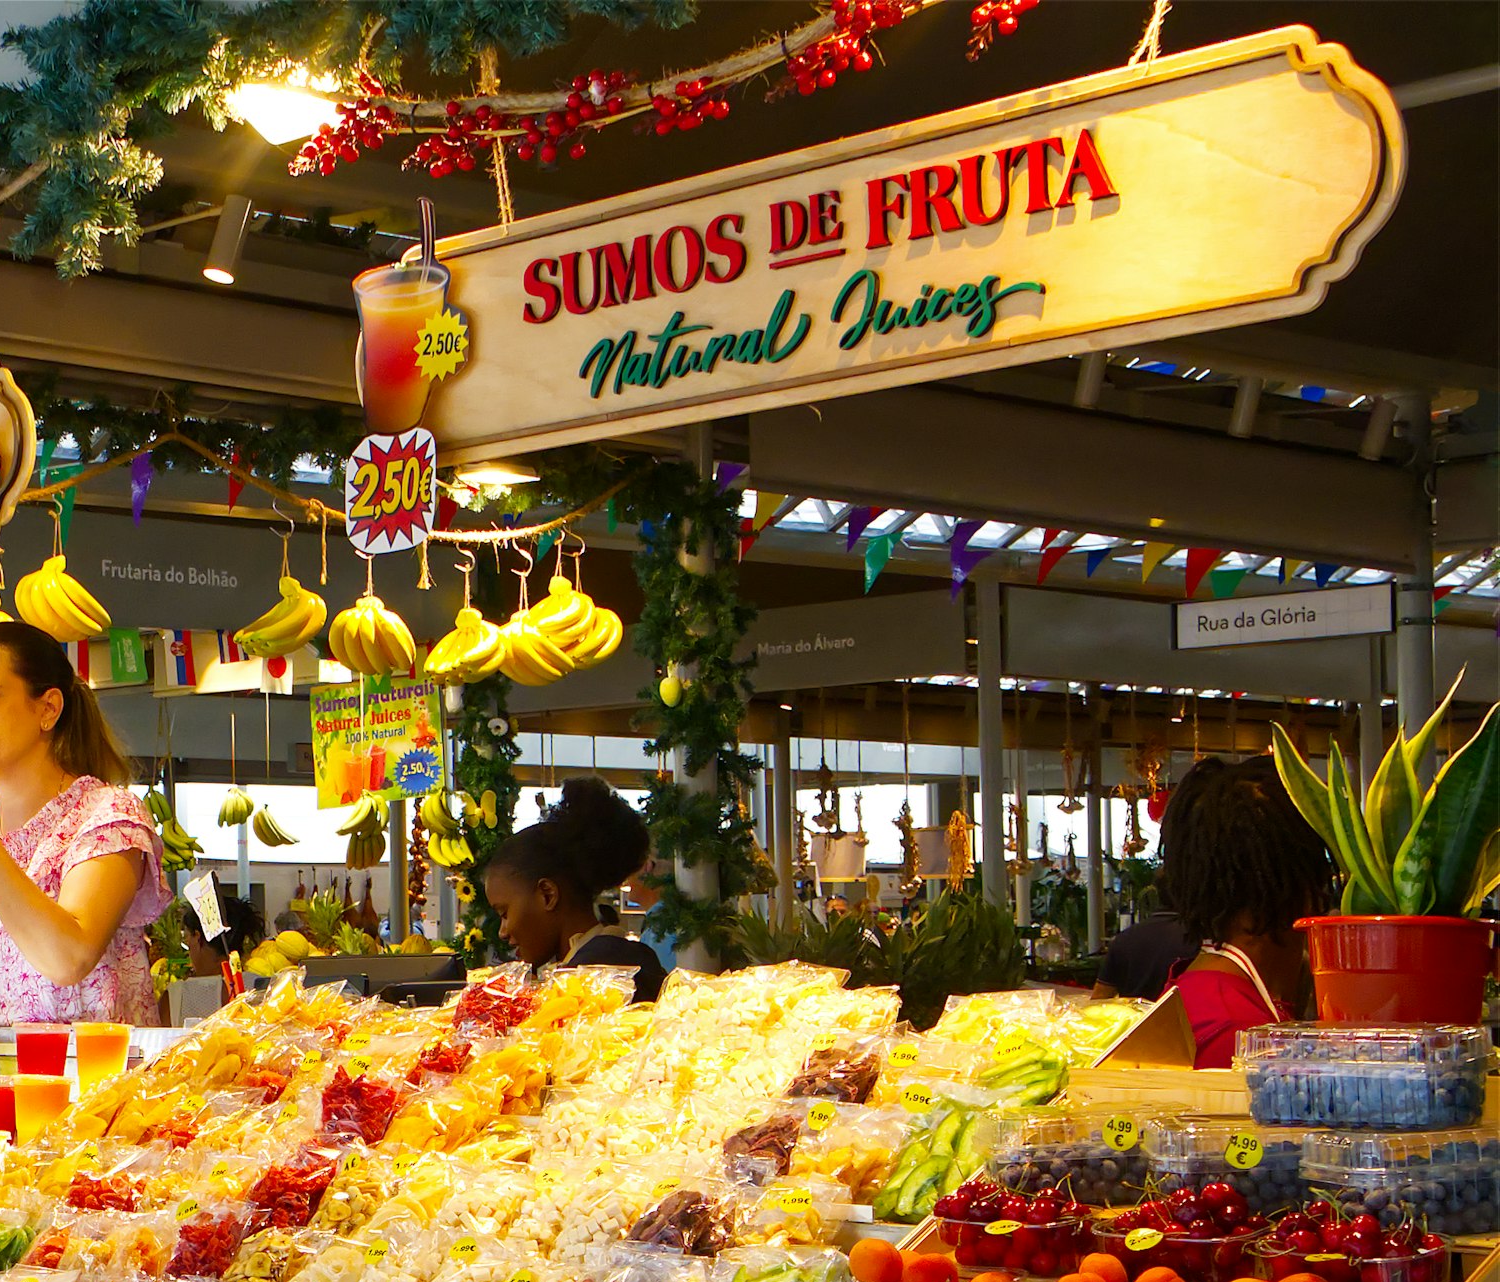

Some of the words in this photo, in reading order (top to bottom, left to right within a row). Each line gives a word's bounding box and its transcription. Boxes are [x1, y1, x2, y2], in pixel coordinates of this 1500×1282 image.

[523, 214, 747, 325] SUMOS
[769, 190, 844, 256] DE
[866, 129, 1119, 249] FRUTA
[580, 288, 812, 399] Natural
[832, 269, 1046, 351] Juices
[423, 332, 462, 358] 2,50€
[350, 457, 433, 521] 2,50€
[101, 559, 161, 582] Frutaria
[164, 566, 185, 584] do
[188, 567, 238, 588] Bolhão
[1197, 615, 1229, 632] Rua
[1234, 611, 1255, 629] da
[1261, 606, 1317, 627] Glória
[757, 642, 793, 656] Maria
[795, 640, 812, 653] do
[814, 633, 855, 651] Álvaro
[370, 707, 412, 727] Juices
[372, 725, 406, 741] Natural
[892, 1052, 918, 1062] 1,99€
[904, 1091, 932, 1106] 1,99€
[1106, 1120, 1133, 1135] 4.99
[1114, 1134, 1125, 1148] €
[1231, 1134, 1258, 1152] 4.99
[1235, 1152, 1247, 1165] €
[783, 1196, 811, 1205] 1,99€
